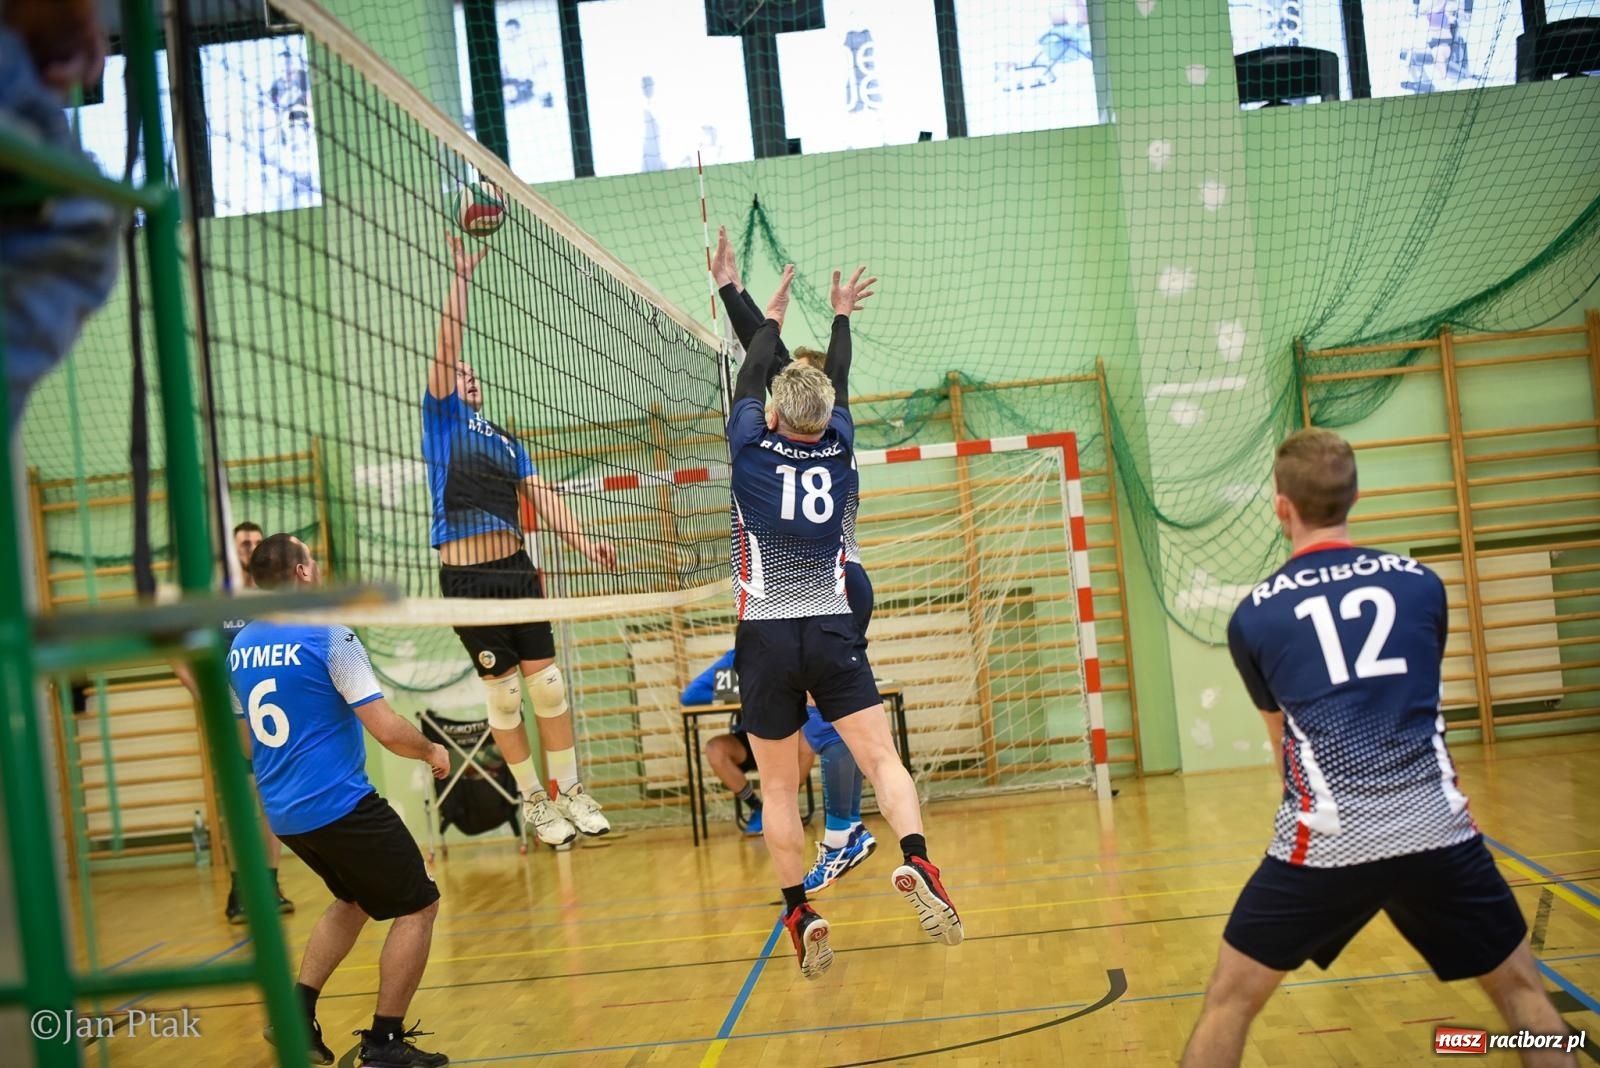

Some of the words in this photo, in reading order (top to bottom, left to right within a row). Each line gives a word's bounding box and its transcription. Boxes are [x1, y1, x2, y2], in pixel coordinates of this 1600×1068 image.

[775, 464, 834, 524] 18
[1251, 553, 1425, 608] RACIBÓRZ
[230, 643, 303, 672] DYMEK
[1293, 585, 1409, 686] 12
[715, 669, 732, 690] 21
[248, 677, 290, 748] 6
